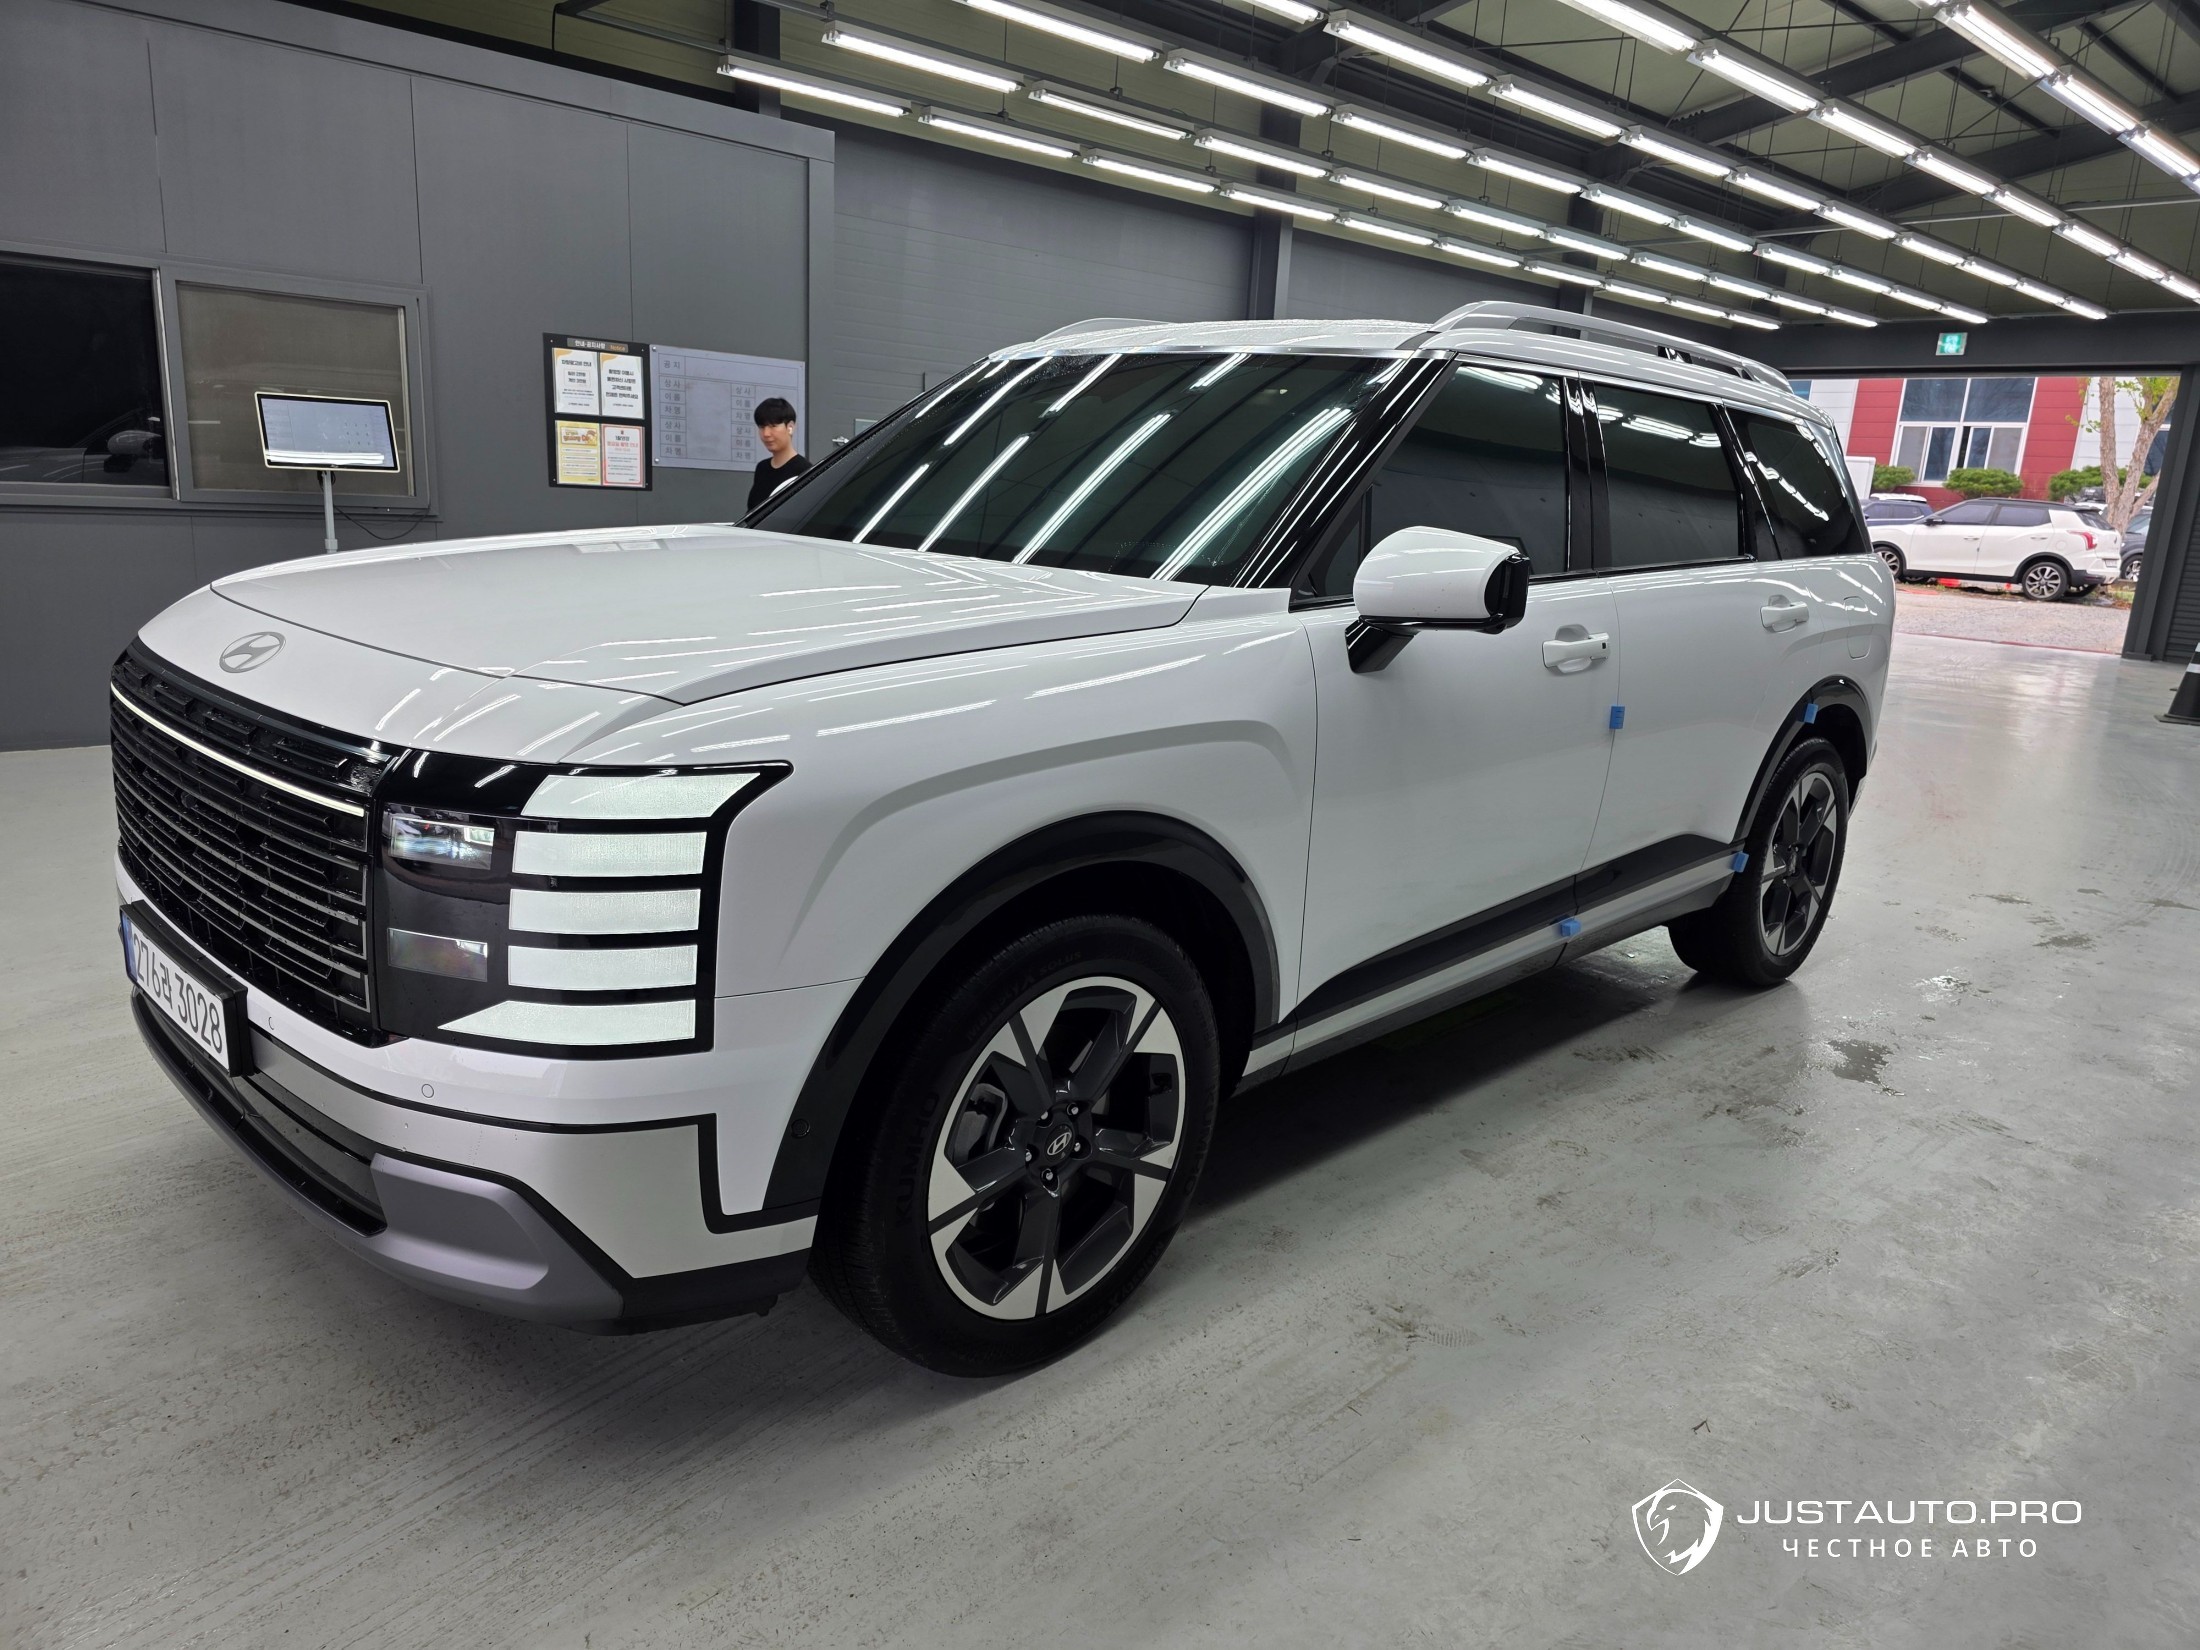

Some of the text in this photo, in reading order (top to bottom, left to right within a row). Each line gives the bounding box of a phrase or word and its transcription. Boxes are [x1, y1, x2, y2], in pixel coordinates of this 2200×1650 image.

[665, 393, 682, 402] 이름
[665, 433, 682, 442] 이름
[133, 933, 223, 1054] 276라 3028
[895, 1091, 940, 1228] KUMHO
